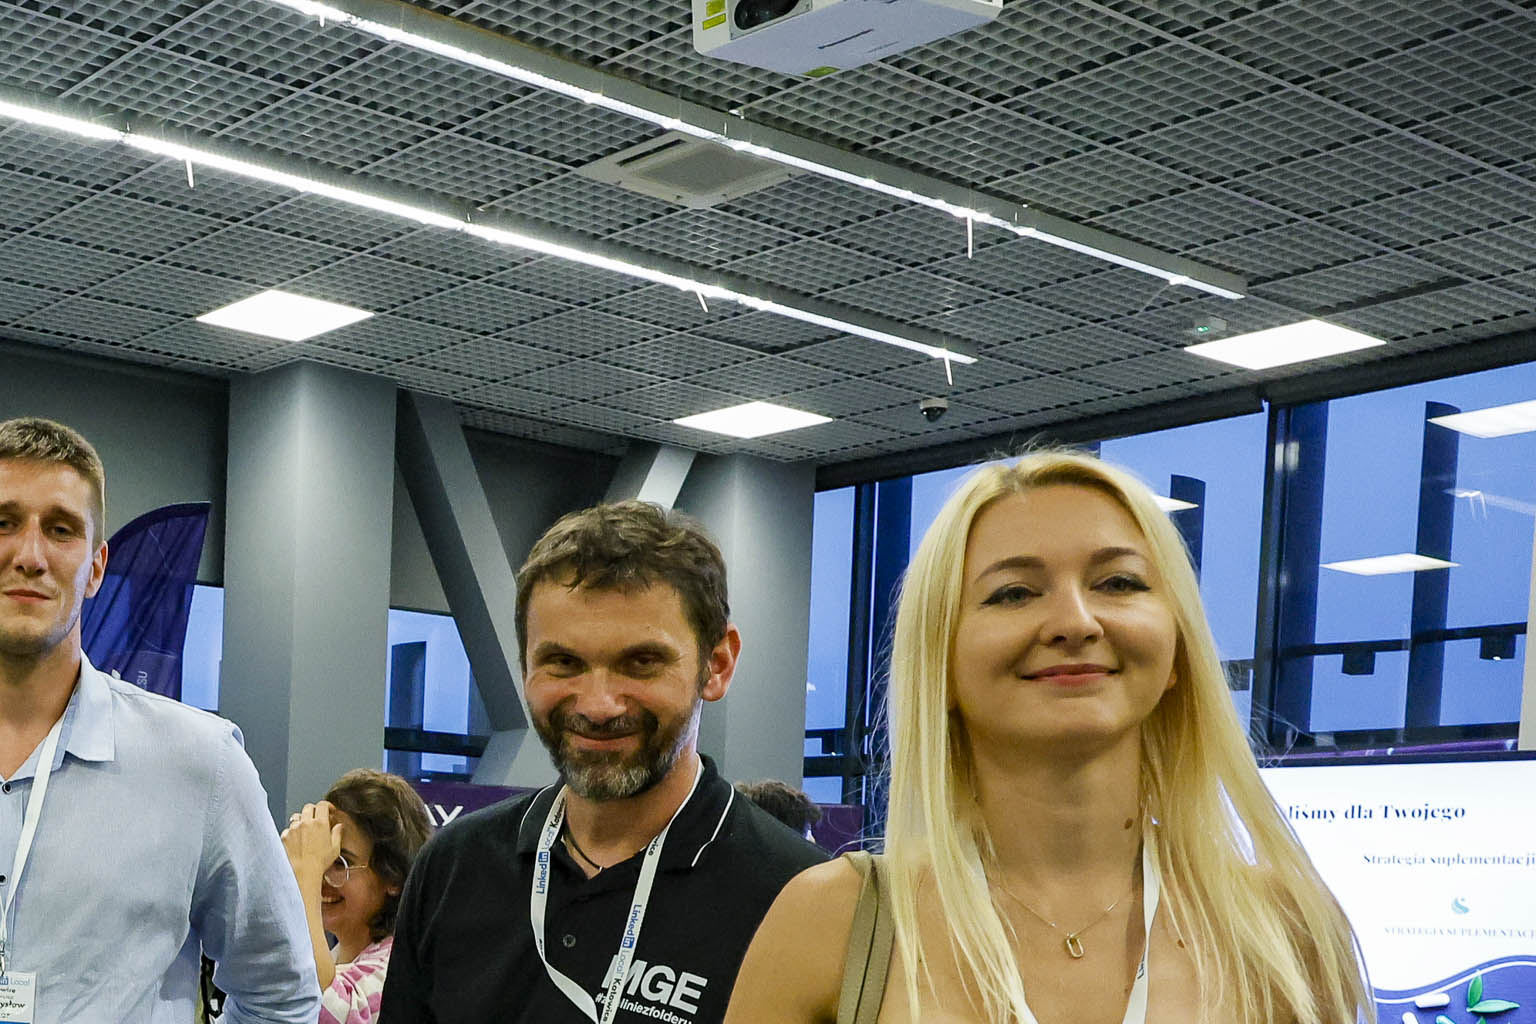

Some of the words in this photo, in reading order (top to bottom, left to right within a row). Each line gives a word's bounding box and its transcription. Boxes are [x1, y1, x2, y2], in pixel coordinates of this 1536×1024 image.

[1344, 804, 1374, 819] dla
[1379, 803, 1466, 823] Twojego
[1363, 854, 1426, 867] Strategia
